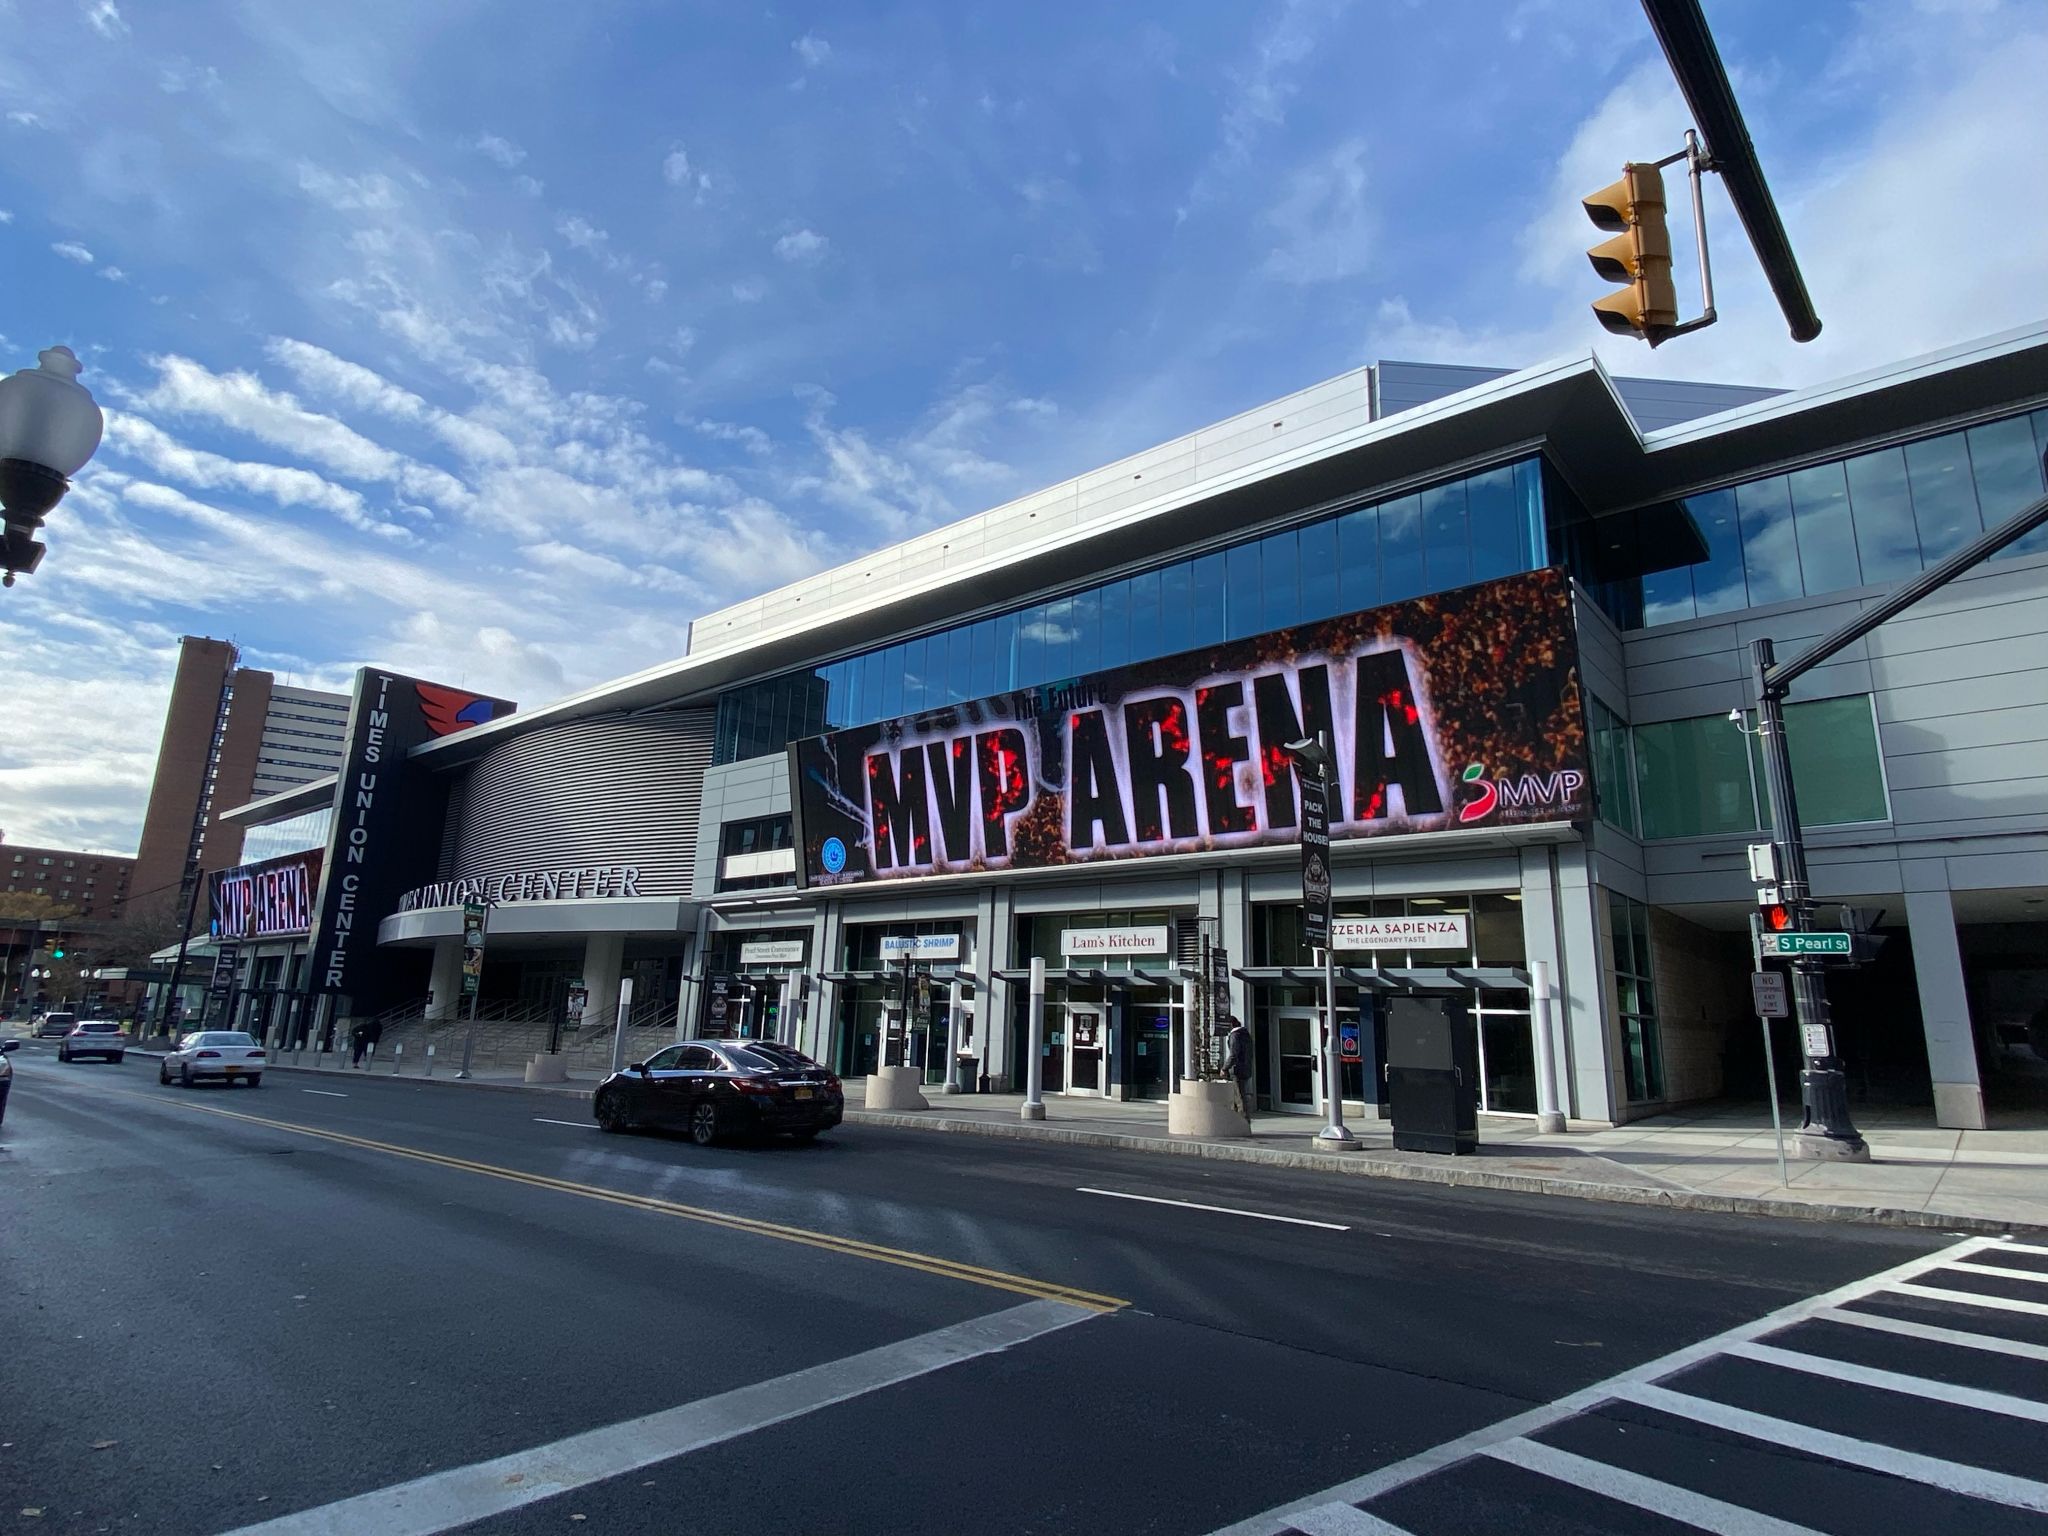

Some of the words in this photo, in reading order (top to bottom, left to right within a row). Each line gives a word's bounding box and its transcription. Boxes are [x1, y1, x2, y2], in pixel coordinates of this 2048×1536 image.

[365, 675, 393, 763] TIMES
[868, 730, 1030, 869] MVP
[1070, 650, 1443, 849] ARENA
[1499, 770, 1583, 807] MVP
[1304, 800, 1324, 814] PACK
[347, 773, 376, 863] UNION
[1308, 816, 1322, 829] THE
[1303, 832, 1328, 845] HOUSE!
[421, 877, 488, 909] UNION
[499, 867, 641, 902] CENTER
[222, 879, 252, 935] MVP
[257, 867, 309, 932] ARENA
[325, 875, 359, 988] CENTER
[1331, 924, 1379, 935] ZZERIA
[1385, 922, 1458, 933] SAPIENZA
[924, 938, 954, 948] SHRIMP
[1073, 936, 1104, 949] Lam's
[1109, 934, 1155, 948] Kitchen
[1781, 938, 1790, 949] S
[1795, 938, 1832, 949] Pearl
[1836, 940, 1848, 949] St
[1762, 976, 1774, 985] NO
